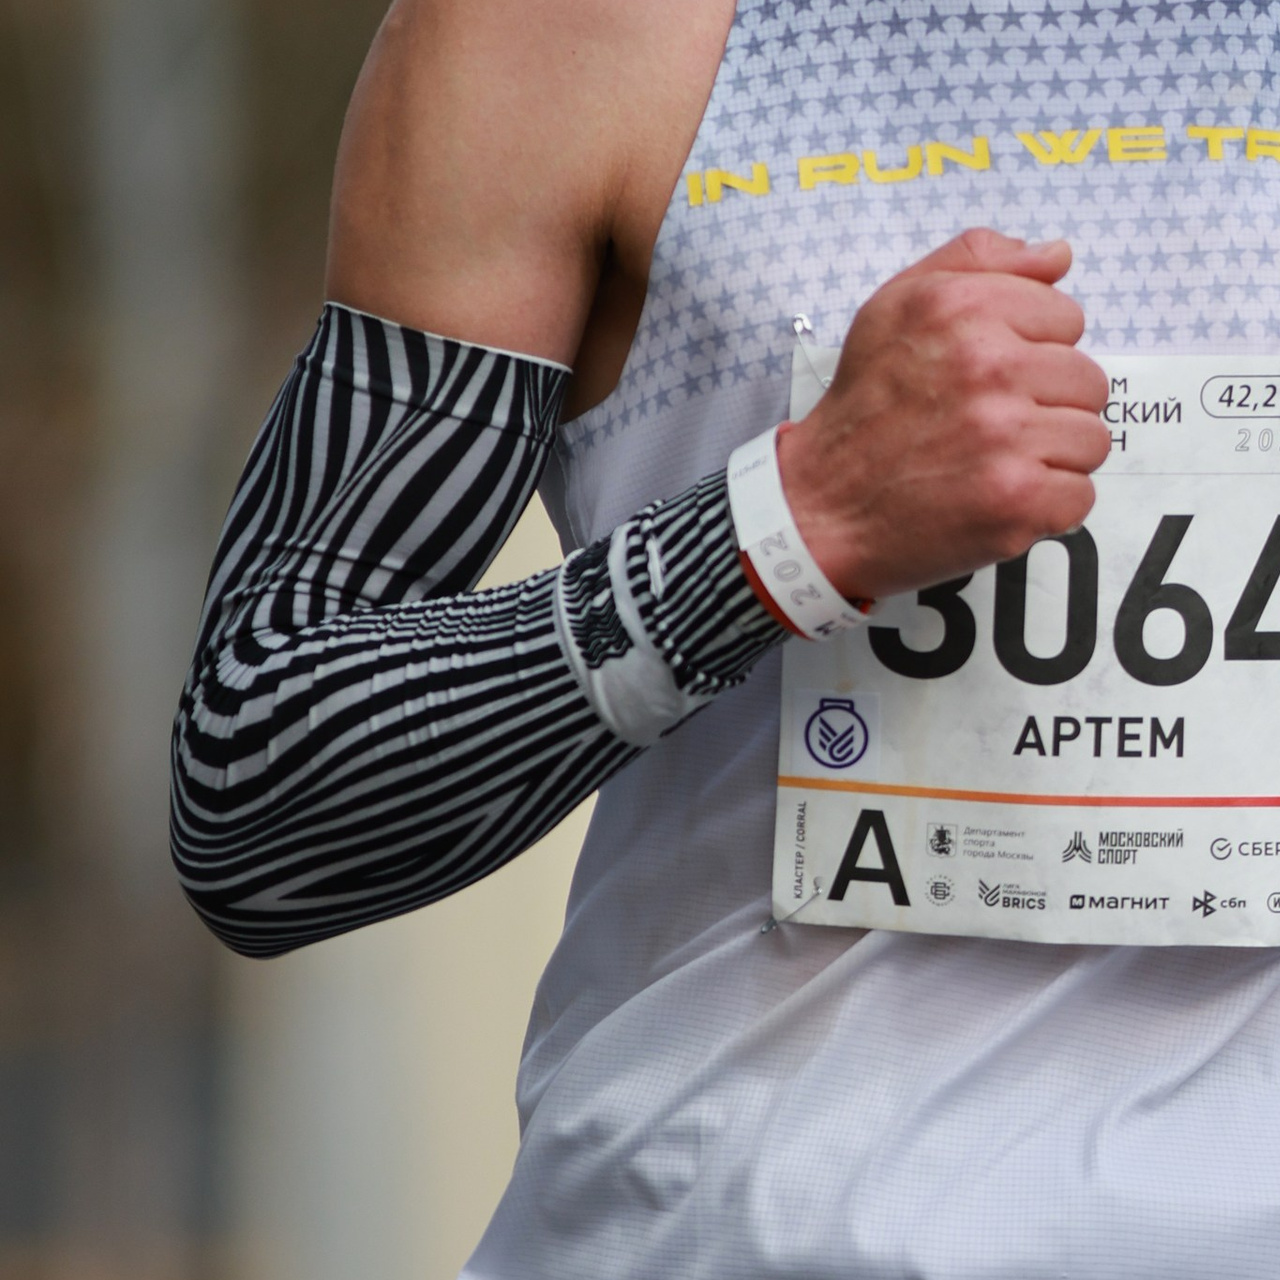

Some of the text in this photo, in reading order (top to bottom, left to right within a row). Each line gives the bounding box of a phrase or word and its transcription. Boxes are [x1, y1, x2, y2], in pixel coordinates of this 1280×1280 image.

[686, 162, 770, 207] IN
[798, 136, 991, 191] RUN
[1015, 126, 1167, 165] WE
[1218, 384, 1277, 411] 42,2
[760, 531, 821, 606] 202
[1013, 716, 1185, 758] АРТЕМ
[796, 800, 807, 842] CORRAL
[963, 826, 1025, 838] Департамент
[963, 838, 995, 848] спорта
[1098, 828, 1184, 848] МОСКОВСКИЙ
[827, 808, 911, 907] A
[963, 848, 1034, 861] города Москвы
[1098, 849, 1138, 865] СПОРТ
[793, 850, 805, 899] КЛАСТЕР
[1002, 896, 1046, 910] BRICS
